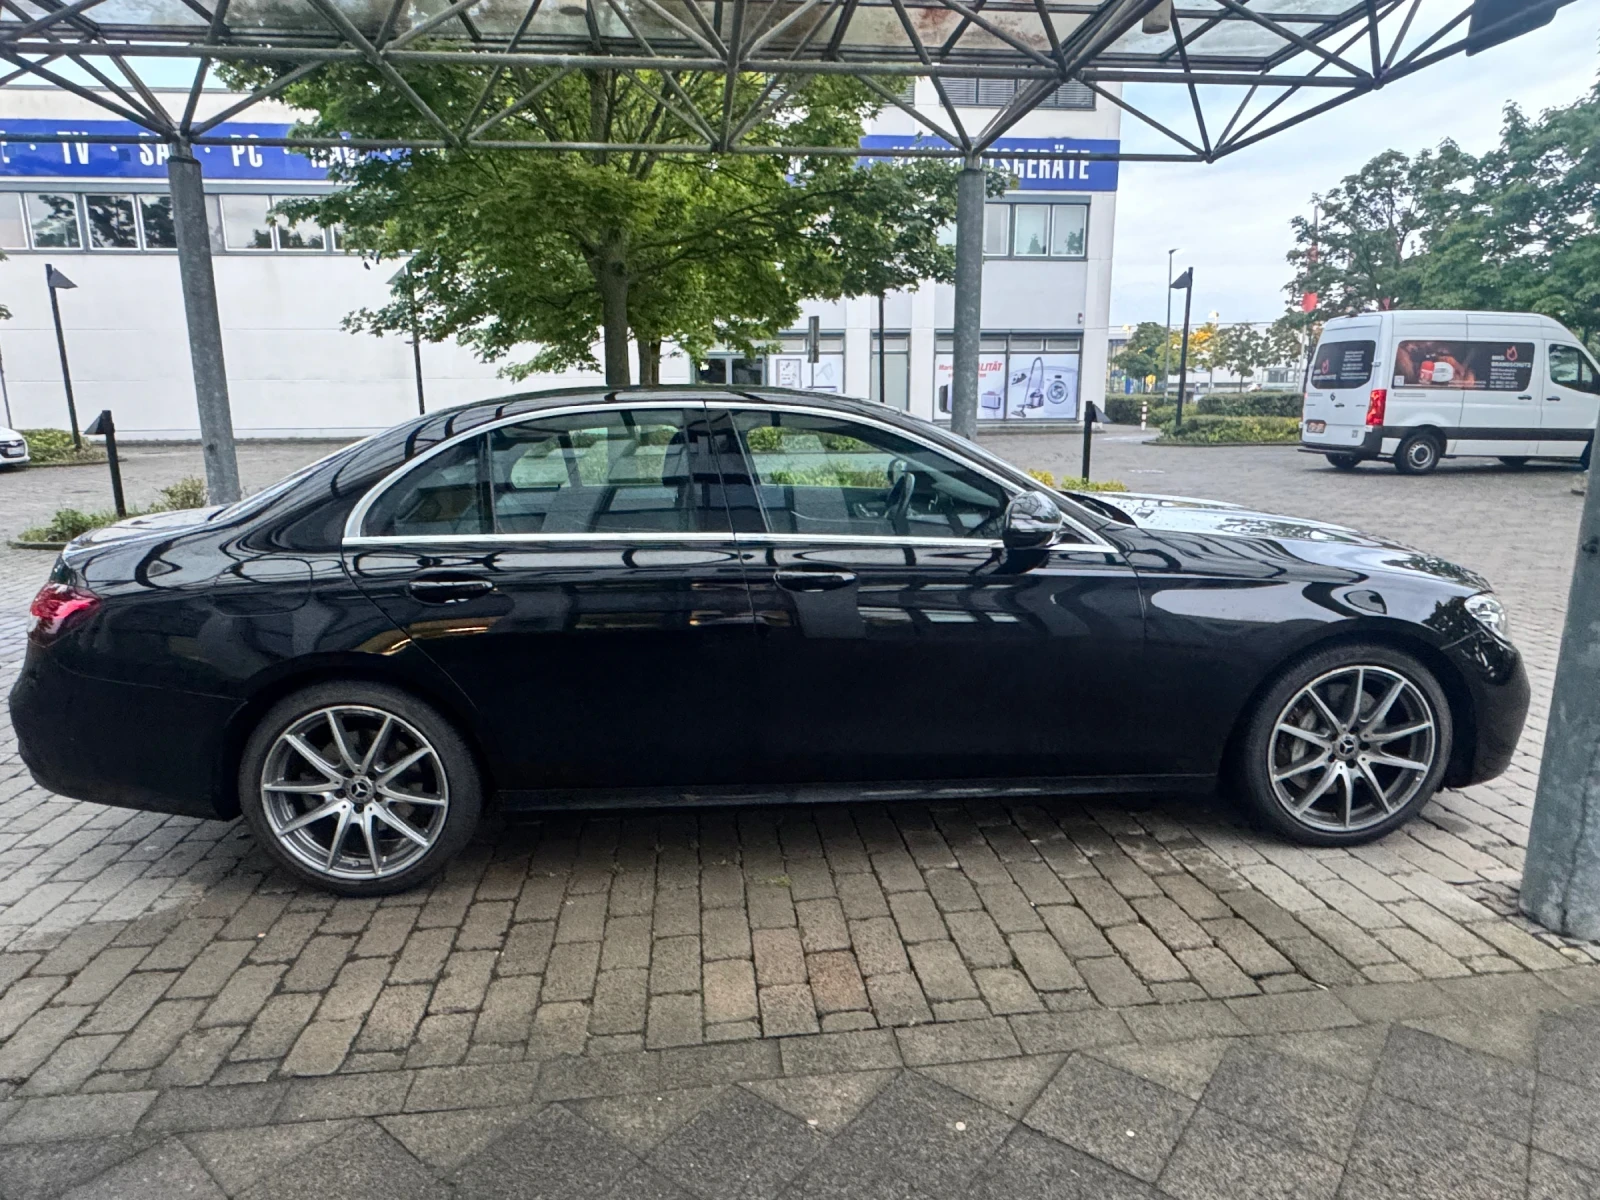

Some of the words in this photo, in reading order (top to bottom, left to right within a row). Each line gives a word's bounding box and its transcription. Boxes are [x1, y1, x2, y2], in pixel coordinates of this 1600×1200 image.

[56, 131, 89, 165] TV
[139, 132, 171, 166] SA
[230, 133, 263, 168] PC
